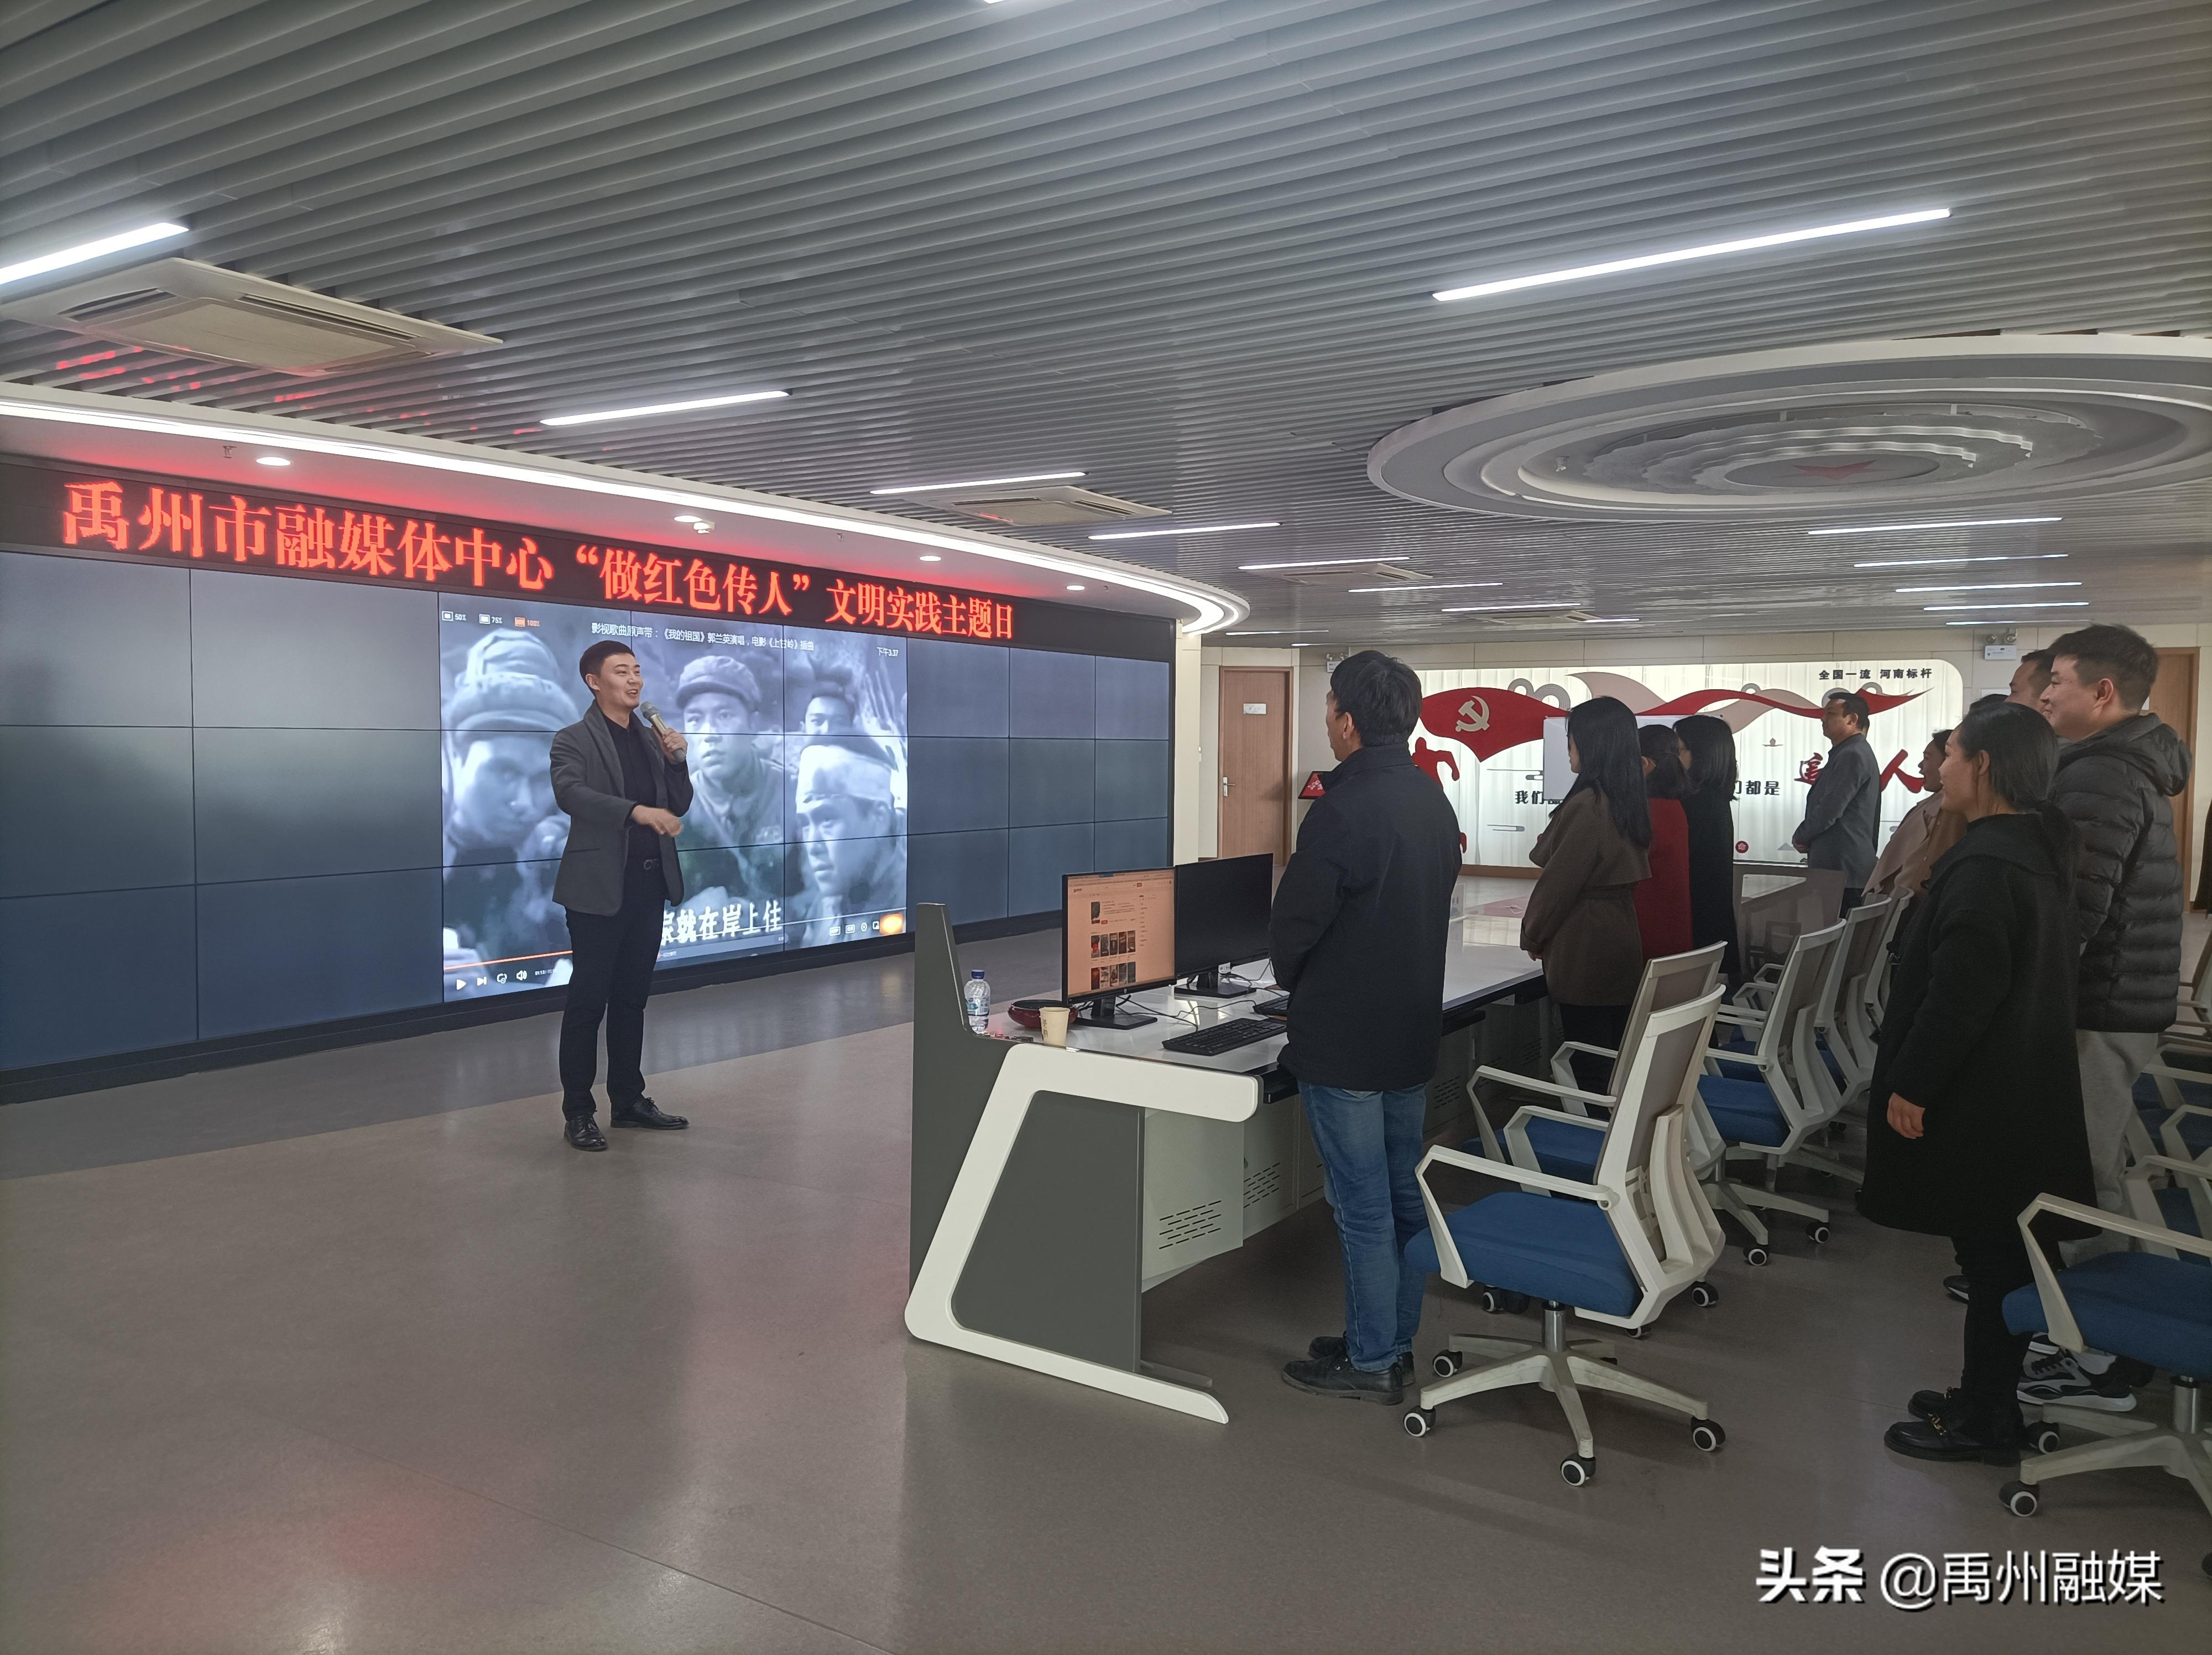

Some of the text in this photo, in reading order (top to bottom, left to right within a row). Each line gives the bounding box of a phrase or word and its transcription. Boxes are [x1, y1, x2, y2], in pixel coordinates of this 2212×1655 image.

[1819, 668, 1932, 680] 全国一流 河南标杆
[1736, 780, 1780, 795] 都是
